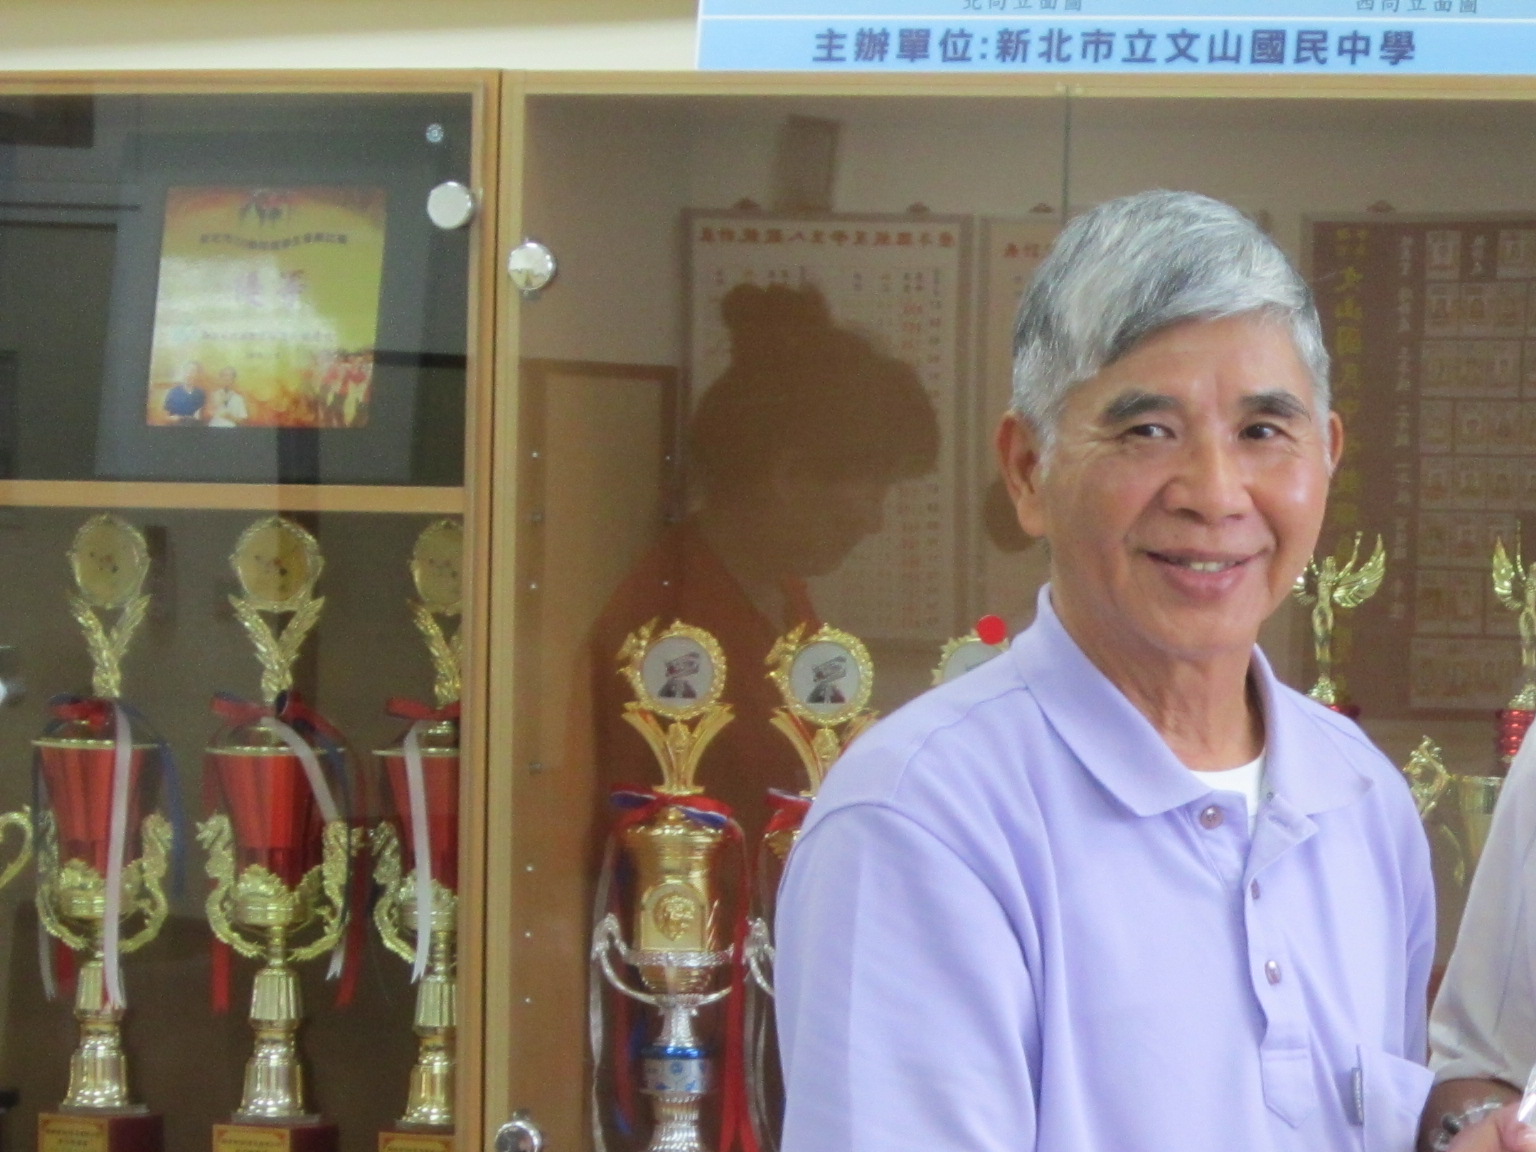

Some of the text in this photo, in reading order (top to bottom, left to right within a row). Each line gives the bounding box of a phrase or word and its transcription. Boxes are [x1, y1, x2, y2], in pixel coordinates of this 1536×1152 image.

[811, 26, 1416, 67] 主辦單位:新北市立文山國民中學
